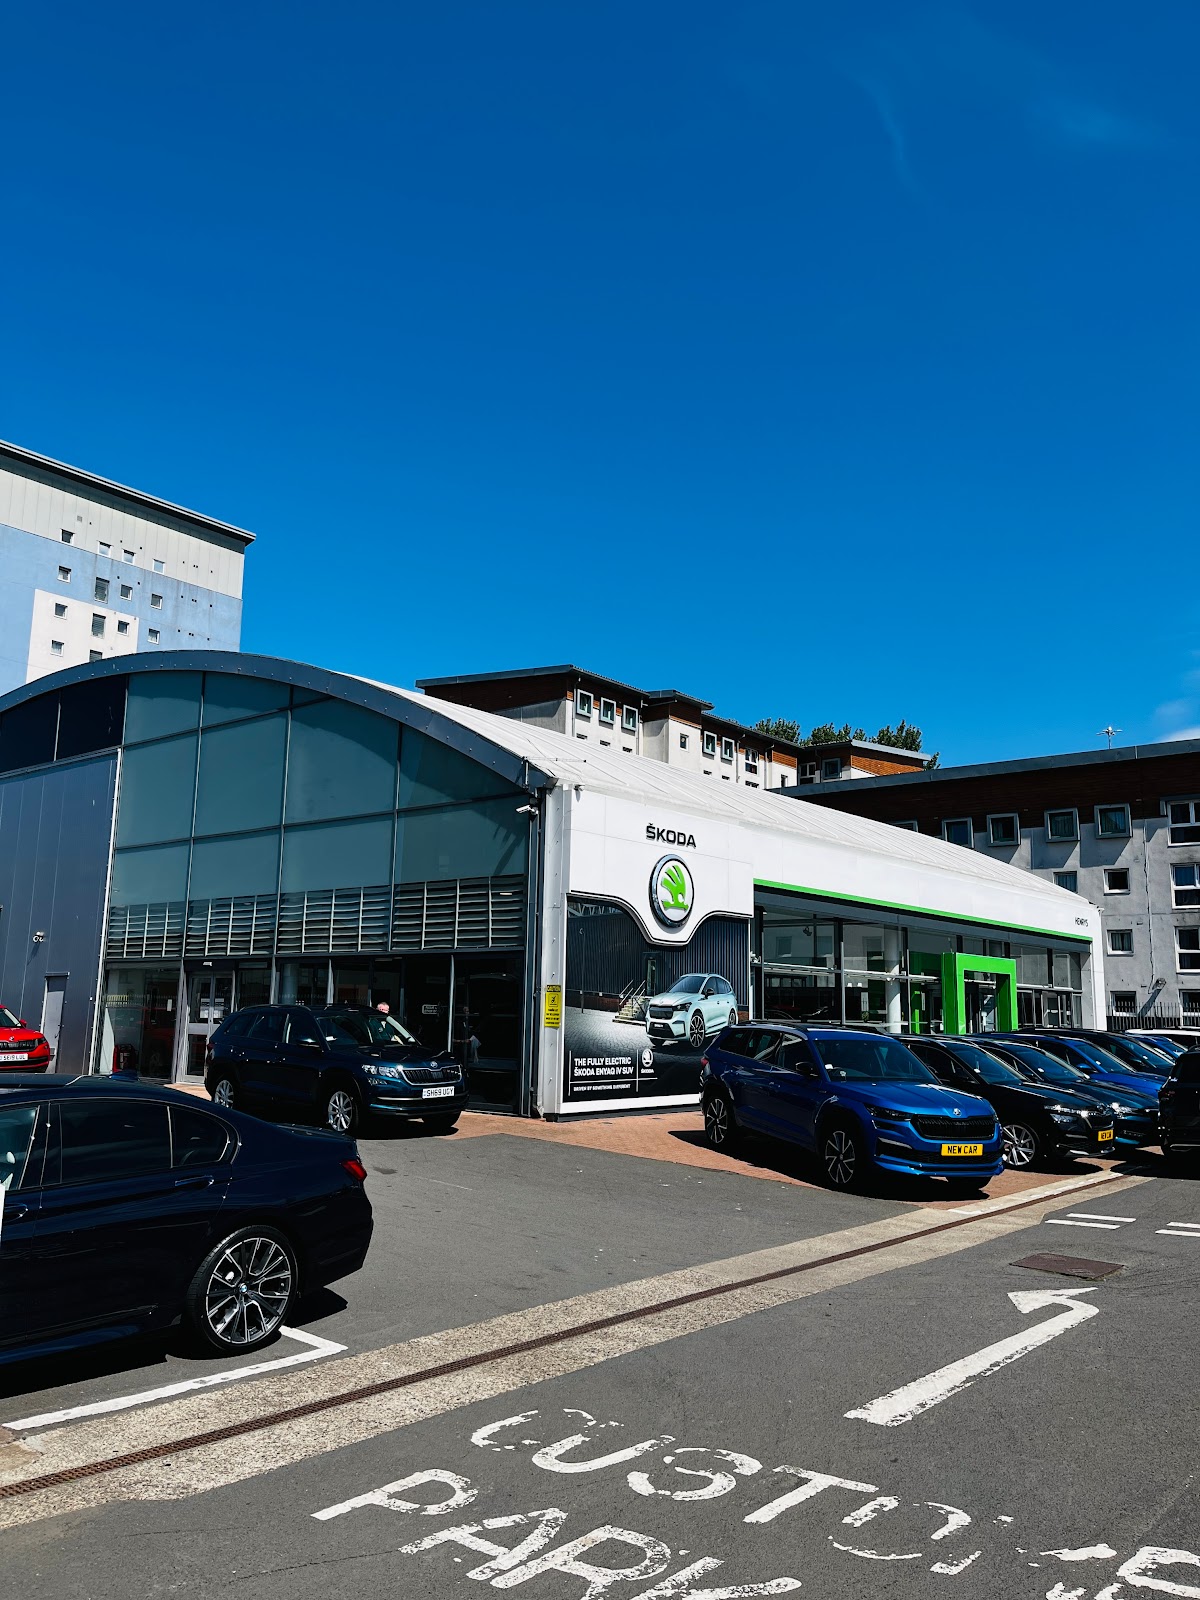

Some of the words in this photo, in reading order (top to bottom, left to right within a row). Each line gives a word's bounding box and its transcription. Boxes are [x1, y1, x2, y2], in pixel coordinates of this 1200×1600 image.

[646, 822, 697, 849] ŠKODA
[574, 1058, 586, 1066] THE
[587, 1057, 604, 1066] FULLY
[605, 1057, 631, 1065] ELECTRIC
[574, 1067, 595, 1077] ŠKODA
[622, 1066, 634, 1075] SUV
[947, 1145, 962, 1154] NEW
[963, 1145, 978, 1154] CAR
